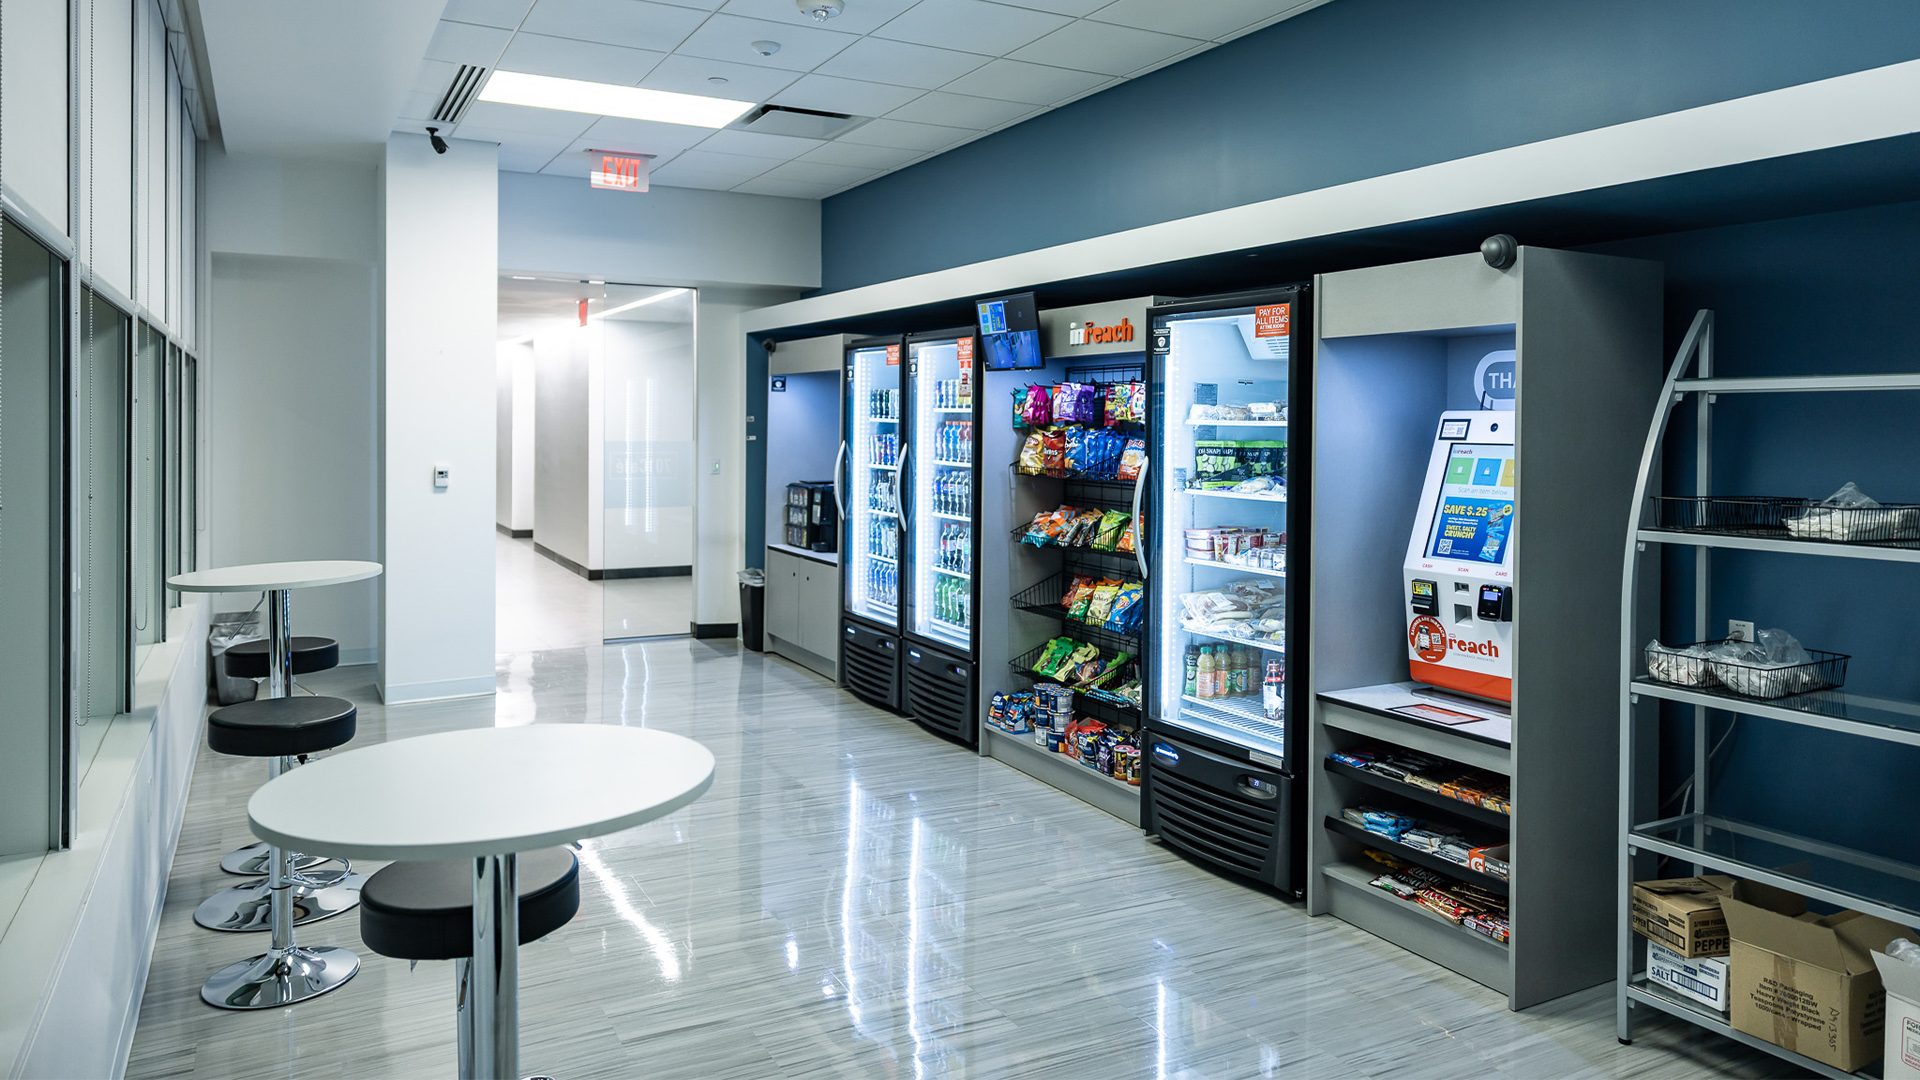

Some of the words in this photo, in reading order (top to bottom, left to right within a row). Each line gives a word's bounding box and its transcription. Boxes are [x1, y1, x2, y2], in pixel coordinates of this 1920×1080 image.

[602, 156, 641, 188] EXIT
[1259, 308, 1271, 317] PAY
[1272, 306, 1286, 315] FOR
[1256, 317, 1268, 325] ALL
[1269, 315, 1289, 324] ITEMS
[1069, 317, 1134, 346] inreach
[1488, 372, 1515, 389] TH
[1492, 488, 1508, 496] below
[1443, 504, 1466, 516] SAVE
[1466, 505, 1488, 517] $.25
[1444, 530, 1476, 539] CRUNCHY
[1651, 966, 1671, 981] SALT
[1759, 983, 1773, 993] Item
[1763, 977, 1778, 987] R&D
[1779, 983, 1814, 1000] Packaging
[1749, 993, 1784, 1011] Teaspoons
[1785, 1006, 1826, 1026] Polystyrene
[1756, 989, 1776, 1001] Heavy
[1776, 994, 1800, 1010] Weight
[1801, 1005, 1821, 1016] Black
[1755, 1002, 1786, 1019] 1000/case
[1791, 1016, 1822, 1031] Wrapped
